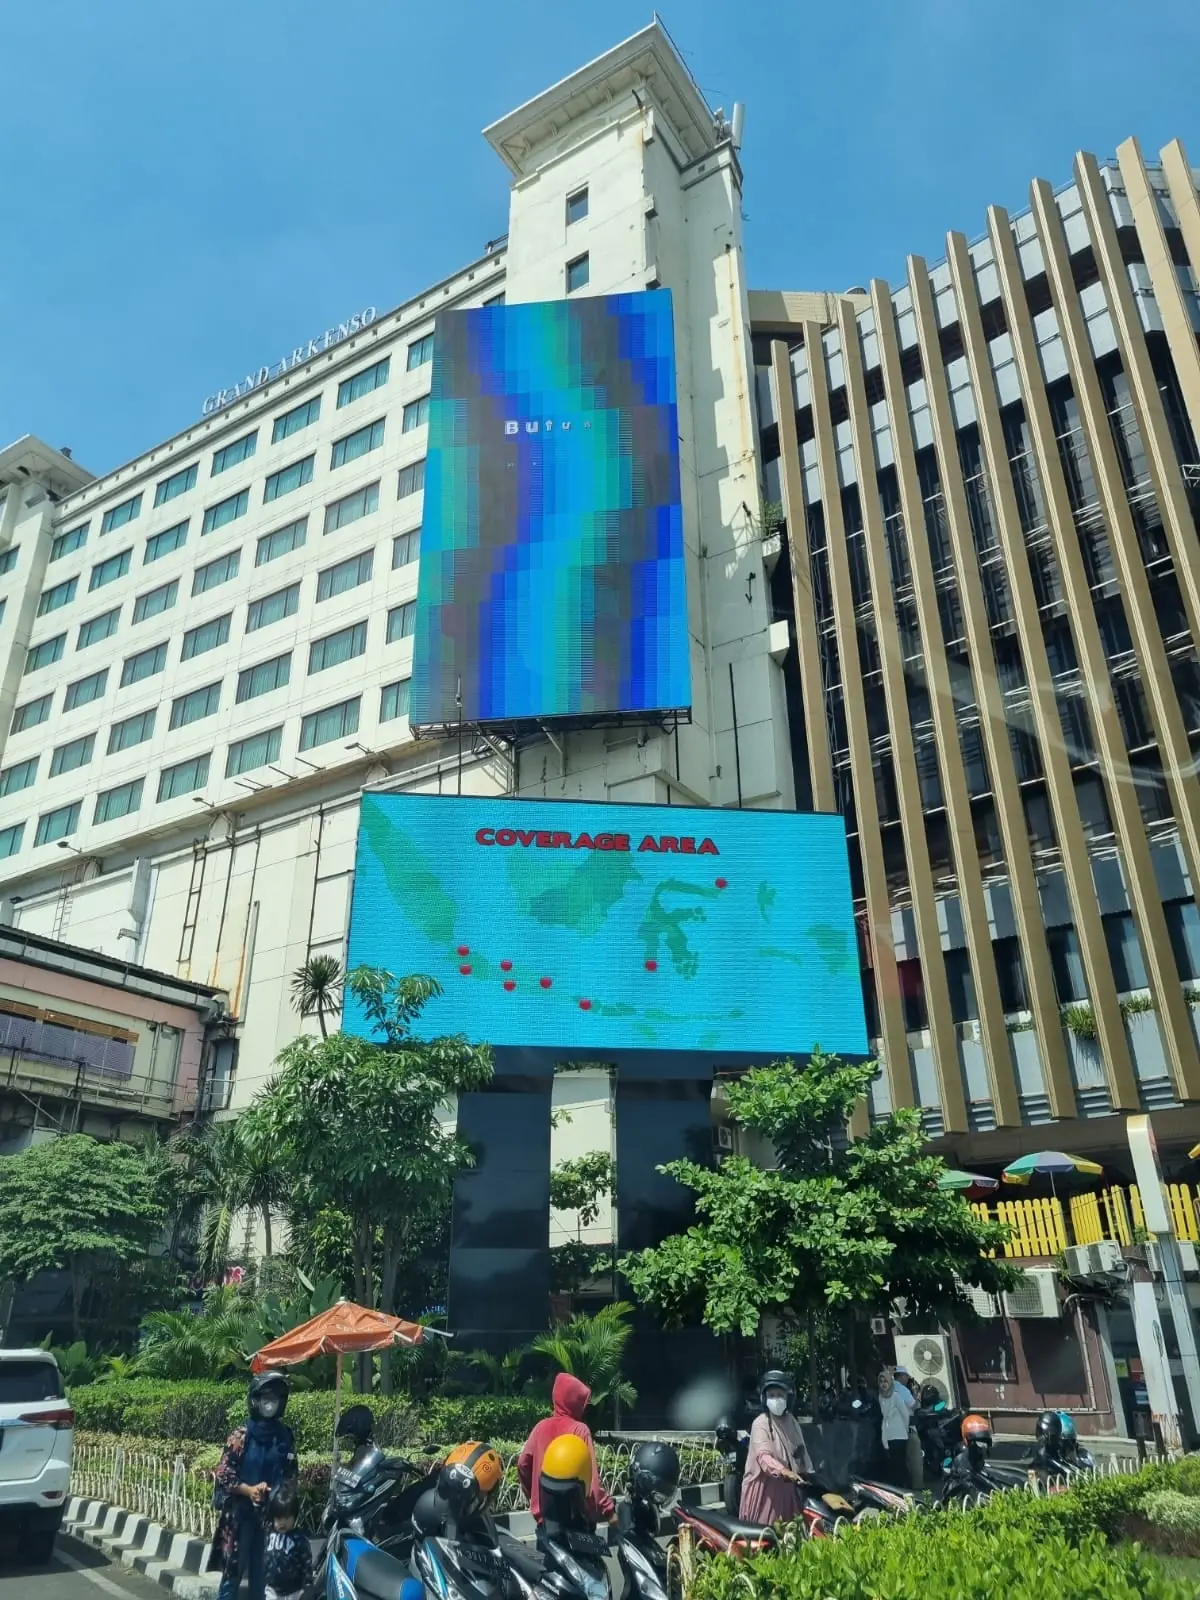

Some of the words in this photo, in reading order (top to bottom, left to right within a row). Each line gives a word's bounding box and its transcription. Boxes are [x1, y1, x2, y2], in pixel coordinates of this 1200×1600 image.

[202, 365, 270, 416] GRAND
[277, 306, 377, 373] ARKENSO
[475, 828, 631, 852] COVERAGE
[637, 834, 721, 856] AREA
